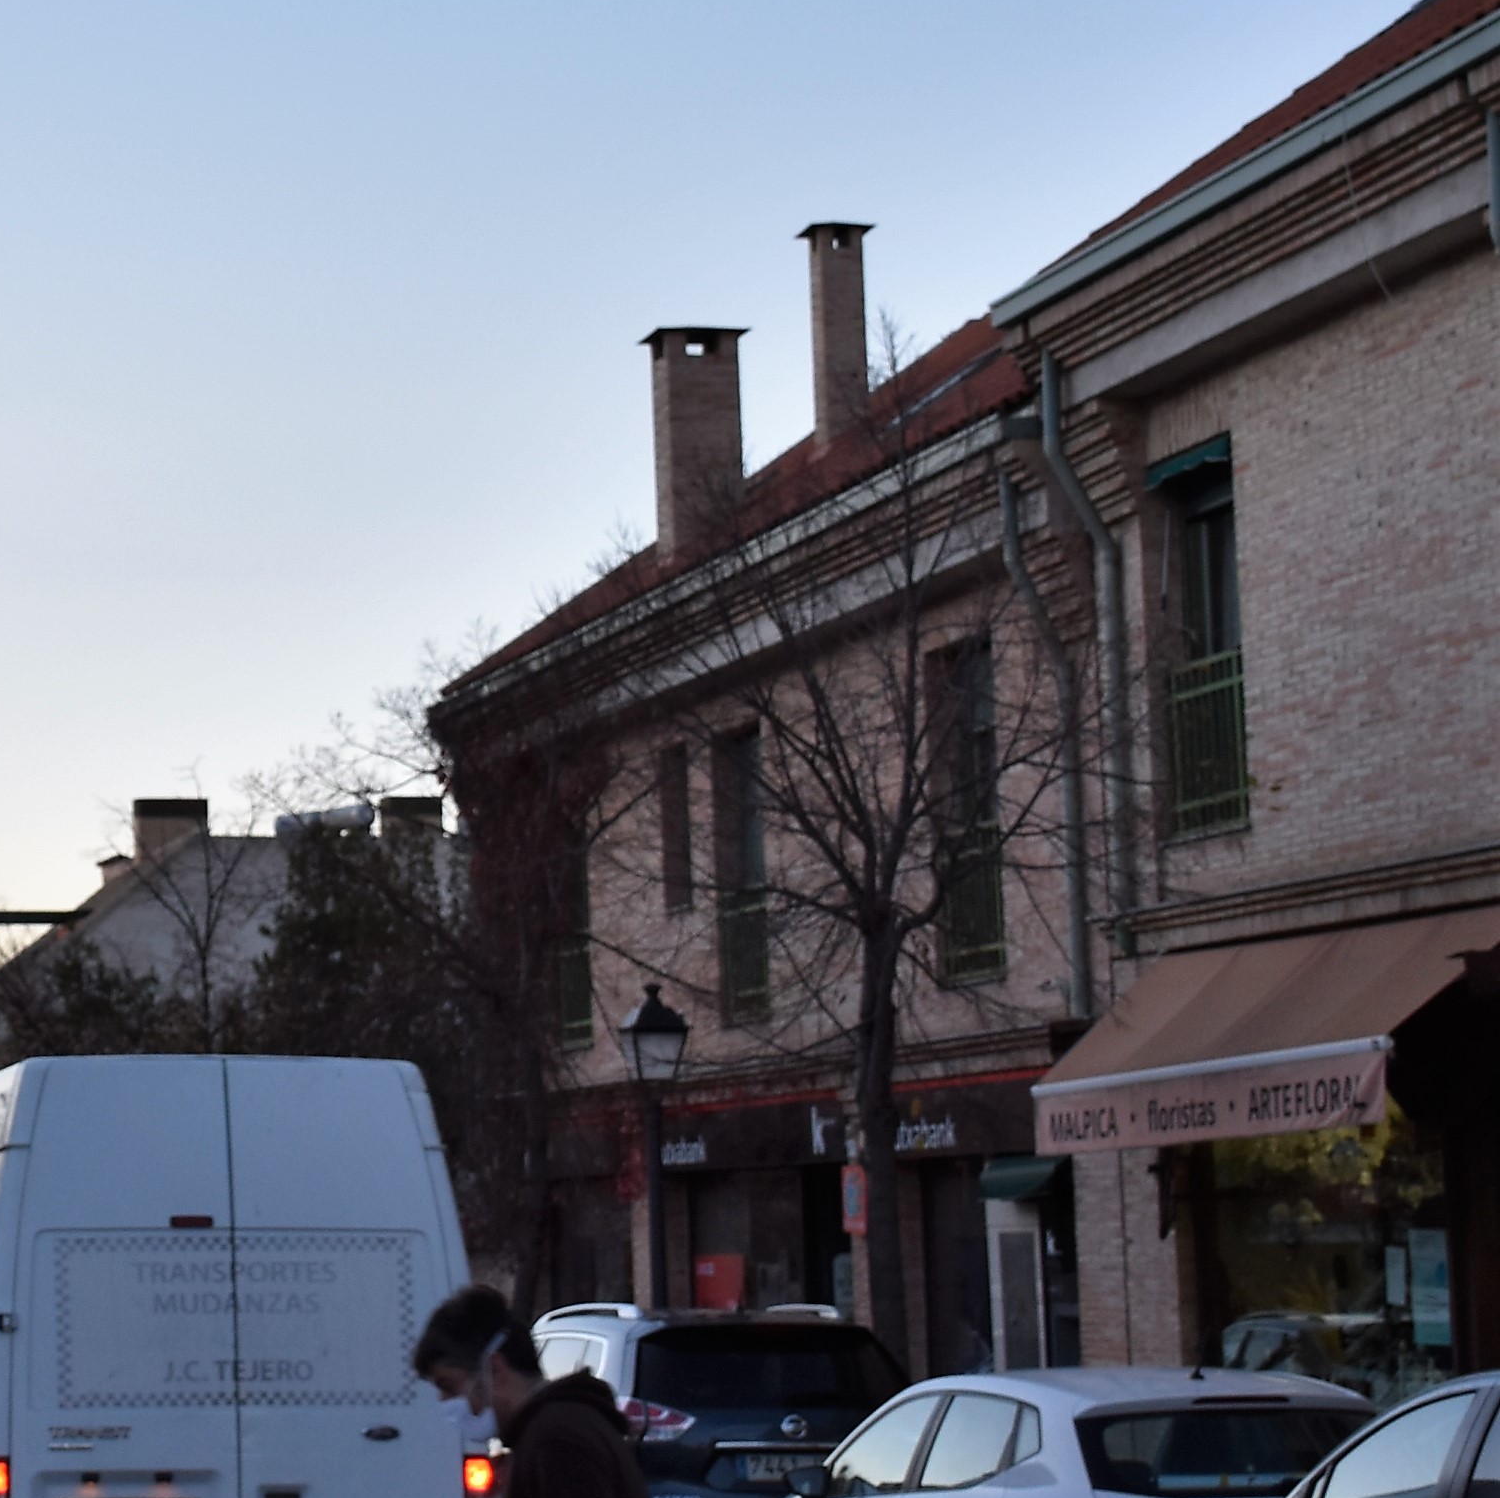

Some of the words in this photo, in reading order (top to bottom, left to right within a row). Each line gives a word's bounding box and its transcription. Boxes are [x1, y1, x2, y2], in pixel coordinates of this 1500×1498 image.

[1051, 1106, 1118, 1141] MALPICA
[1148, 1097, 1216, 1131] floristas
[133, 1261, 337, 1283] TRANSPORTES
[152, 1292, 321, 1314] MUDANZAS
[164, 1360, 209, 1383] J.C.
[213, 1360, 315, 1383] TEJERO
